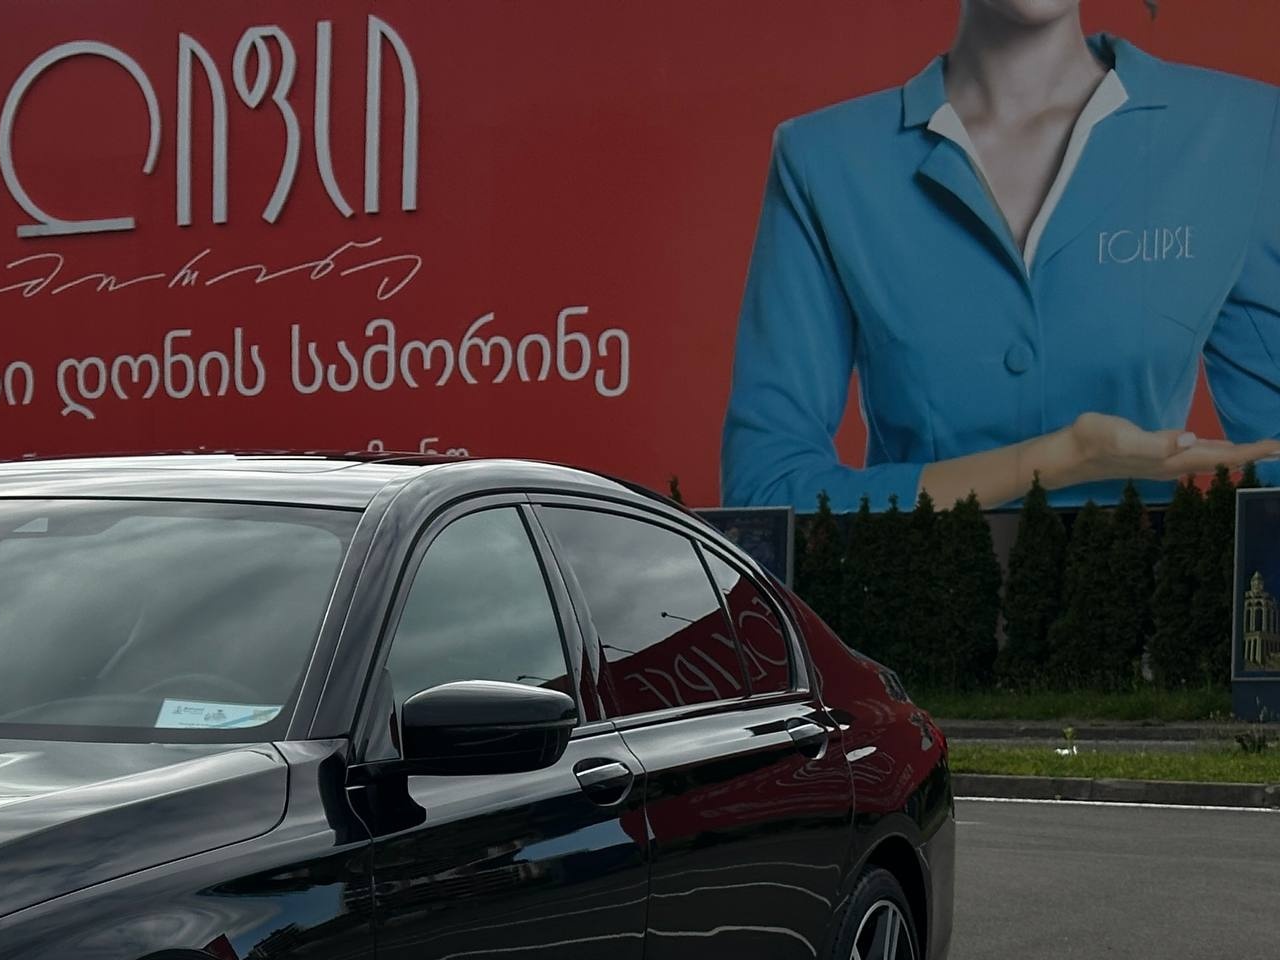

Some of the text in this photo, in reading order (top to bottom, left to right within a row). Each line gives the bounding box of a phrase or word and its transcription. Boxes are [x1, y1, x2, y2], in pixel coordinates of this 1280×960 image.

[1098, 225, 1195, 264] ECLIPSE
[56, 326, 267, 420] დონის
[290, 305, 630, 397] სამორინე
